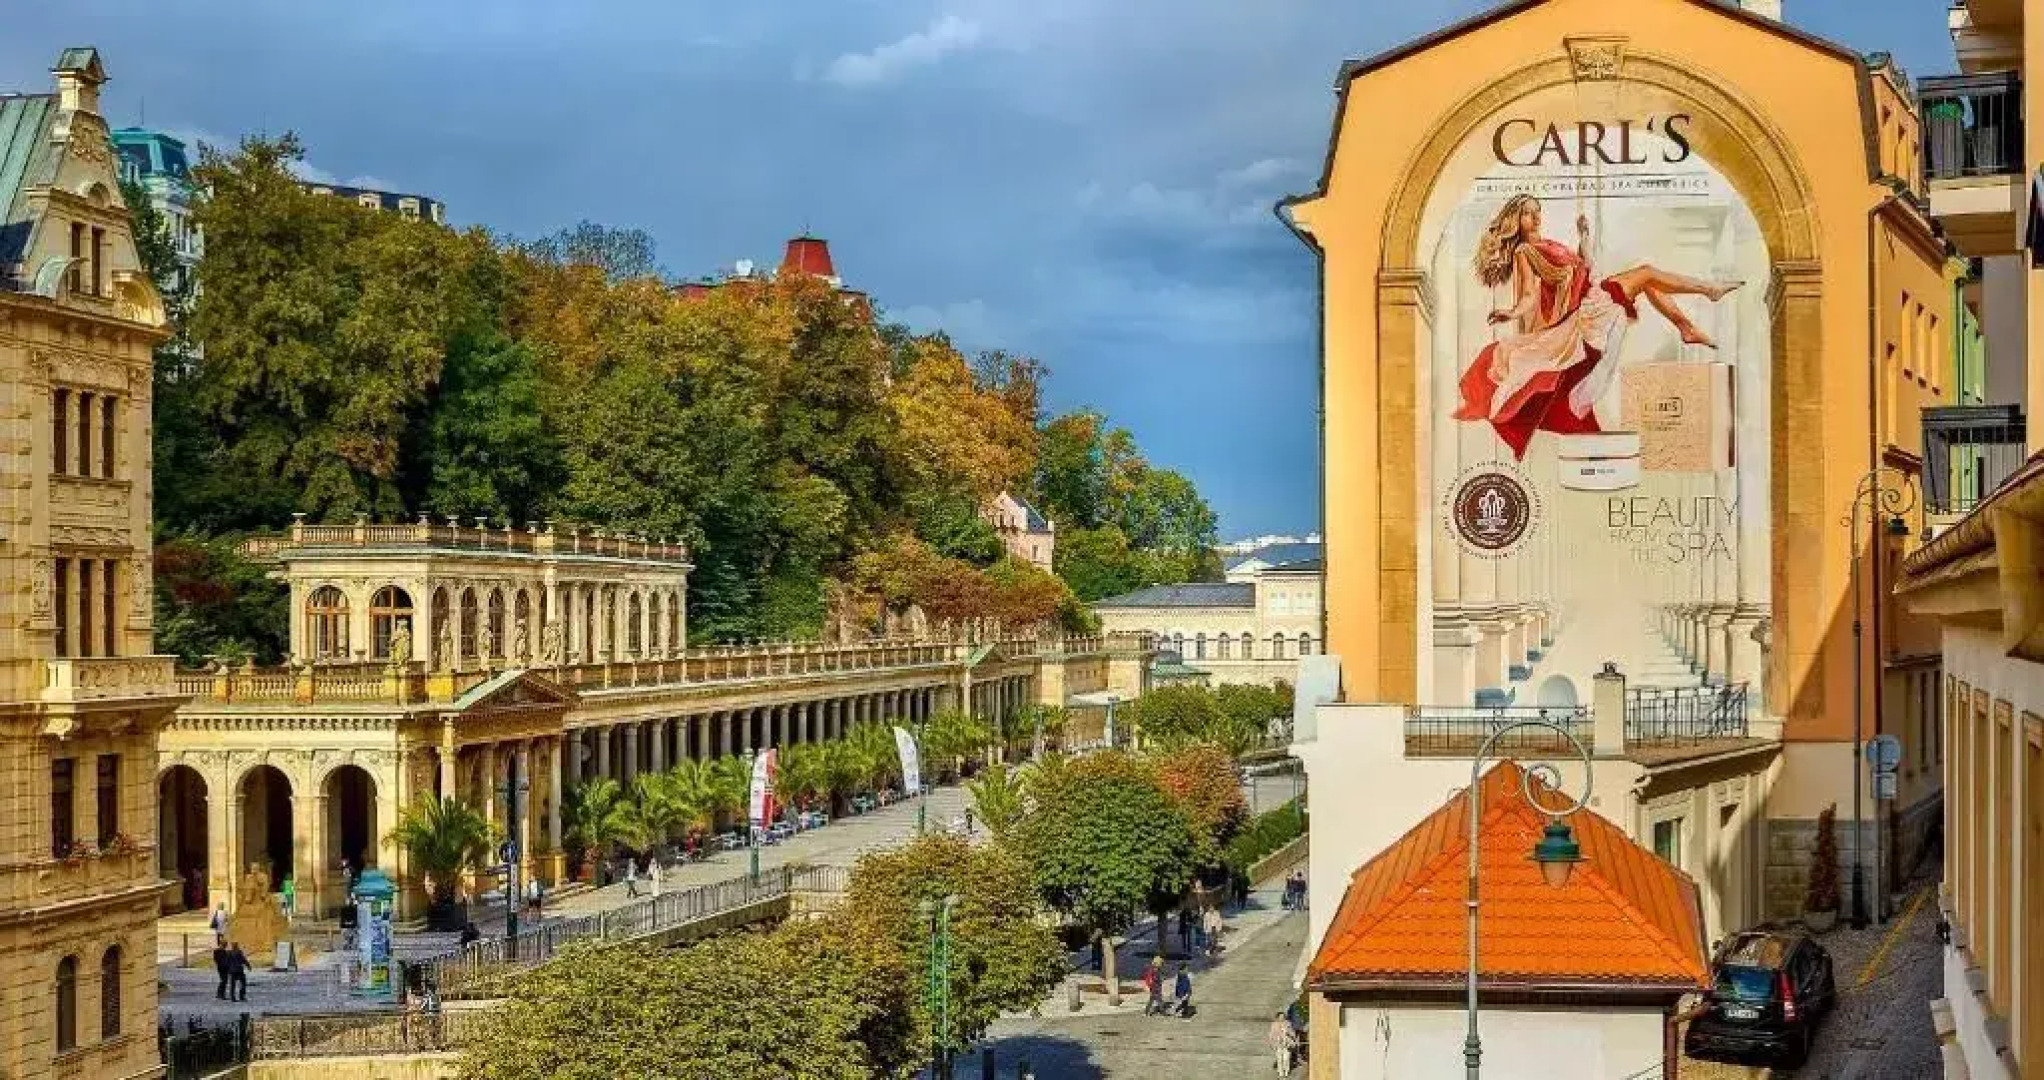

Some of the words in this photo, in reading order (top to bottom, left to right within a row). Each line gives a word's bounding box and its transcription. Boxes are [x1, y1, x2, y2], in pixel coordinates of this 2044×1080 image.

[1493, 113, 1691, 166] CARL'S
[1608, 496, 1739, 528] BEAUTY
[1610, 528, 1661, 543] FROM
[1667, 532, 1732, 564] SPA
